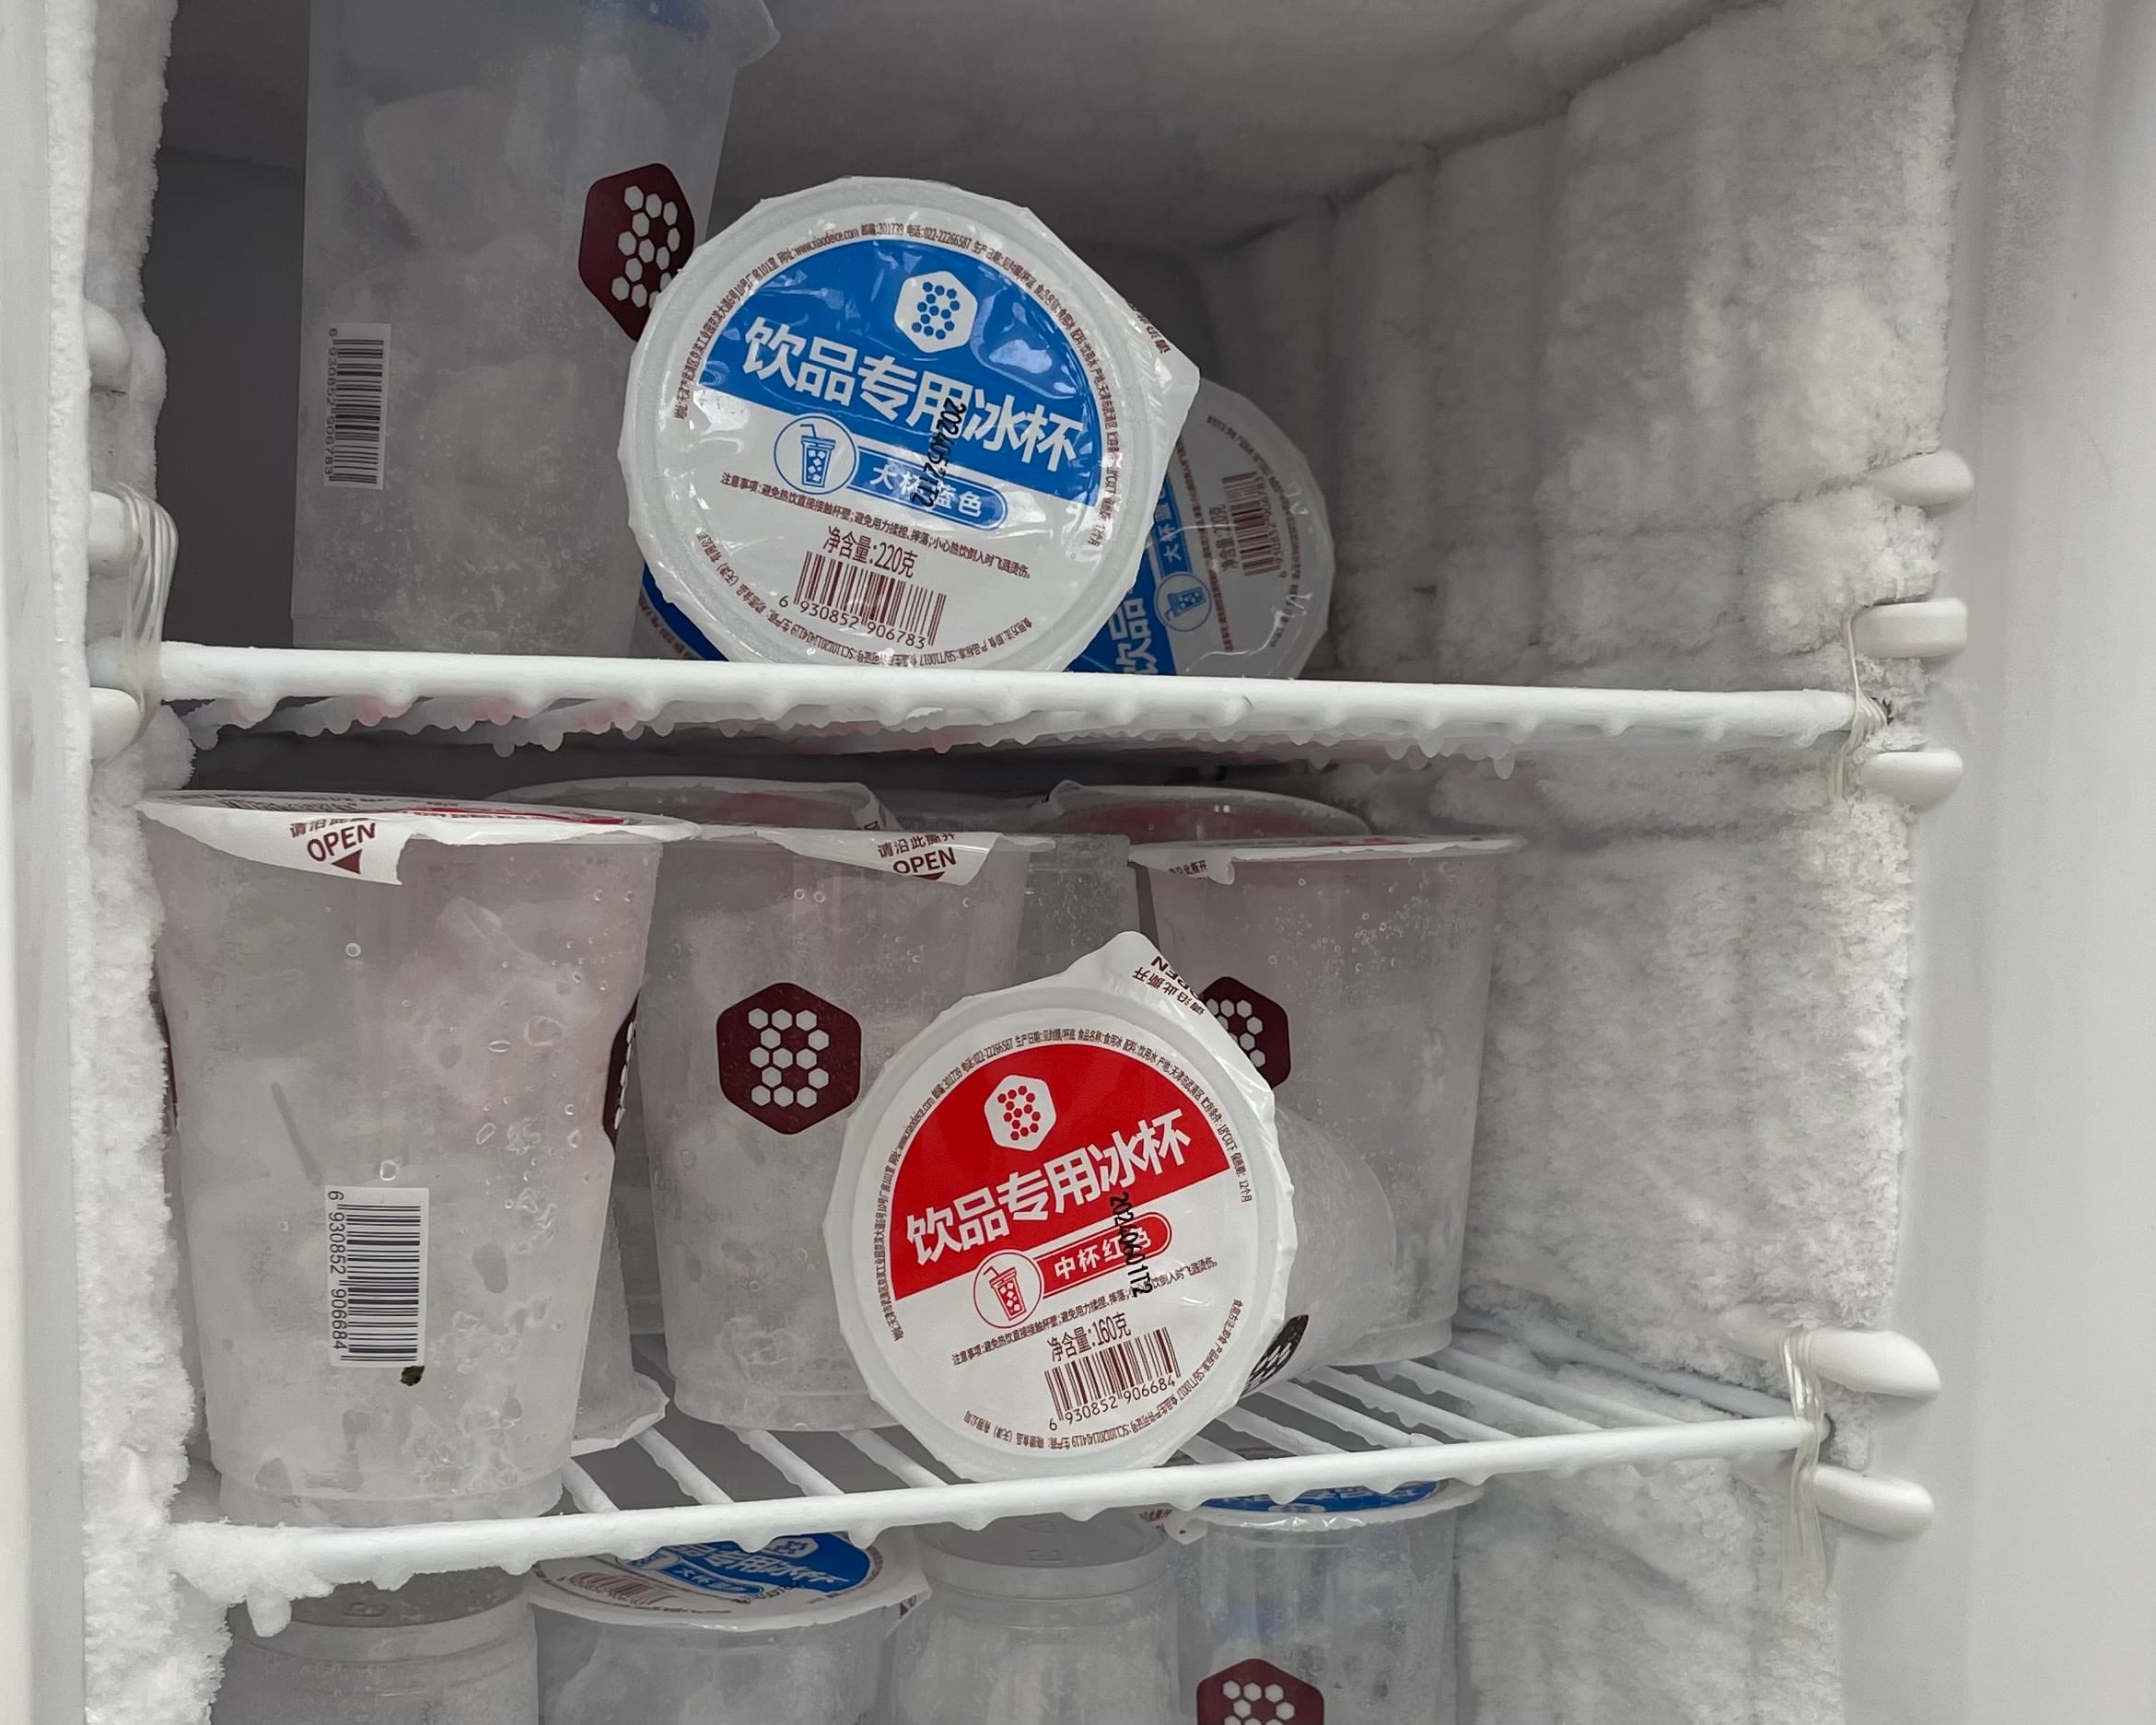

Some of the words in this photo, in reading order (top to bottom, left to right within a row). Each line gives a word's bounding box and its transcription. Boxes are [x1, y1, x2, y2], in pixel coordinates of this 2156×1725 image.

[742, 318, 1086, 472] 饮品专用冰杯
[822, 525, 919, 579] 净含量:220克
[800, 600, 859, 630] 930852
[867, 622, 926, 649] 906783
[1107, 590, 1158, 675] 饮品
[308, 822, 376, 861] OPEN
[893, 847, 957, 874] OPEN
[1150, 956, 1200, 1000] PEN
[905, 1108, 1191, 1264] 饮品专用冰杯
[329, 1212, 346, 1275] 930852
[332, 1289, 348, 1350] 906684
[1047, 1311, 1131, 1362] 净含量:160克
[1066, 1396, 1118, 1425] 930852
[1124, 1375, 1176, 1404] 906684
